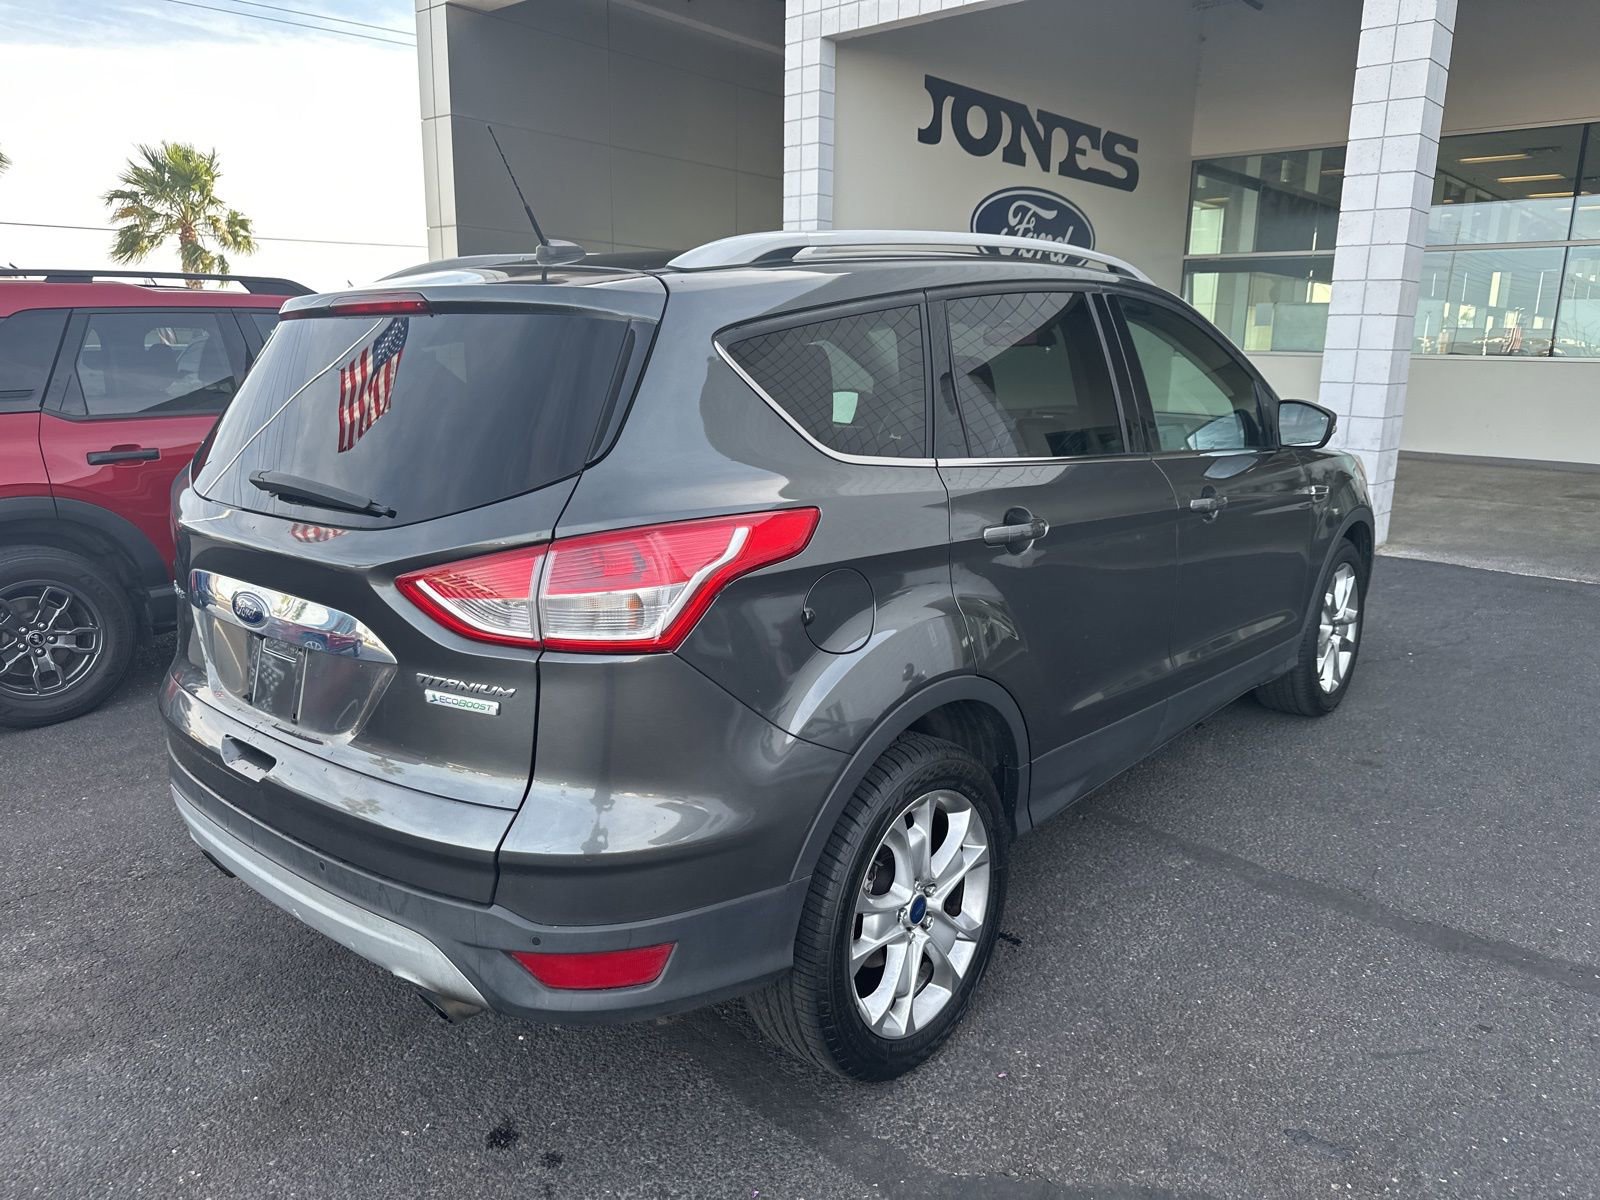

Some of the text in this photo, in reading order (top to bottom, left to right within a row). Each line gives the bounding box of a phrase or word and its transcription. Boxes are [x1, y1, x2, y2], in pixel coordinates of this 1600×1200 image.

[917, 74, 1139, 192] JONES
[235, 598, 257, 619] Ford
[416, 672, 517, 698] TITANIUM
[439, 695, 493, 712] ECOBOOST
